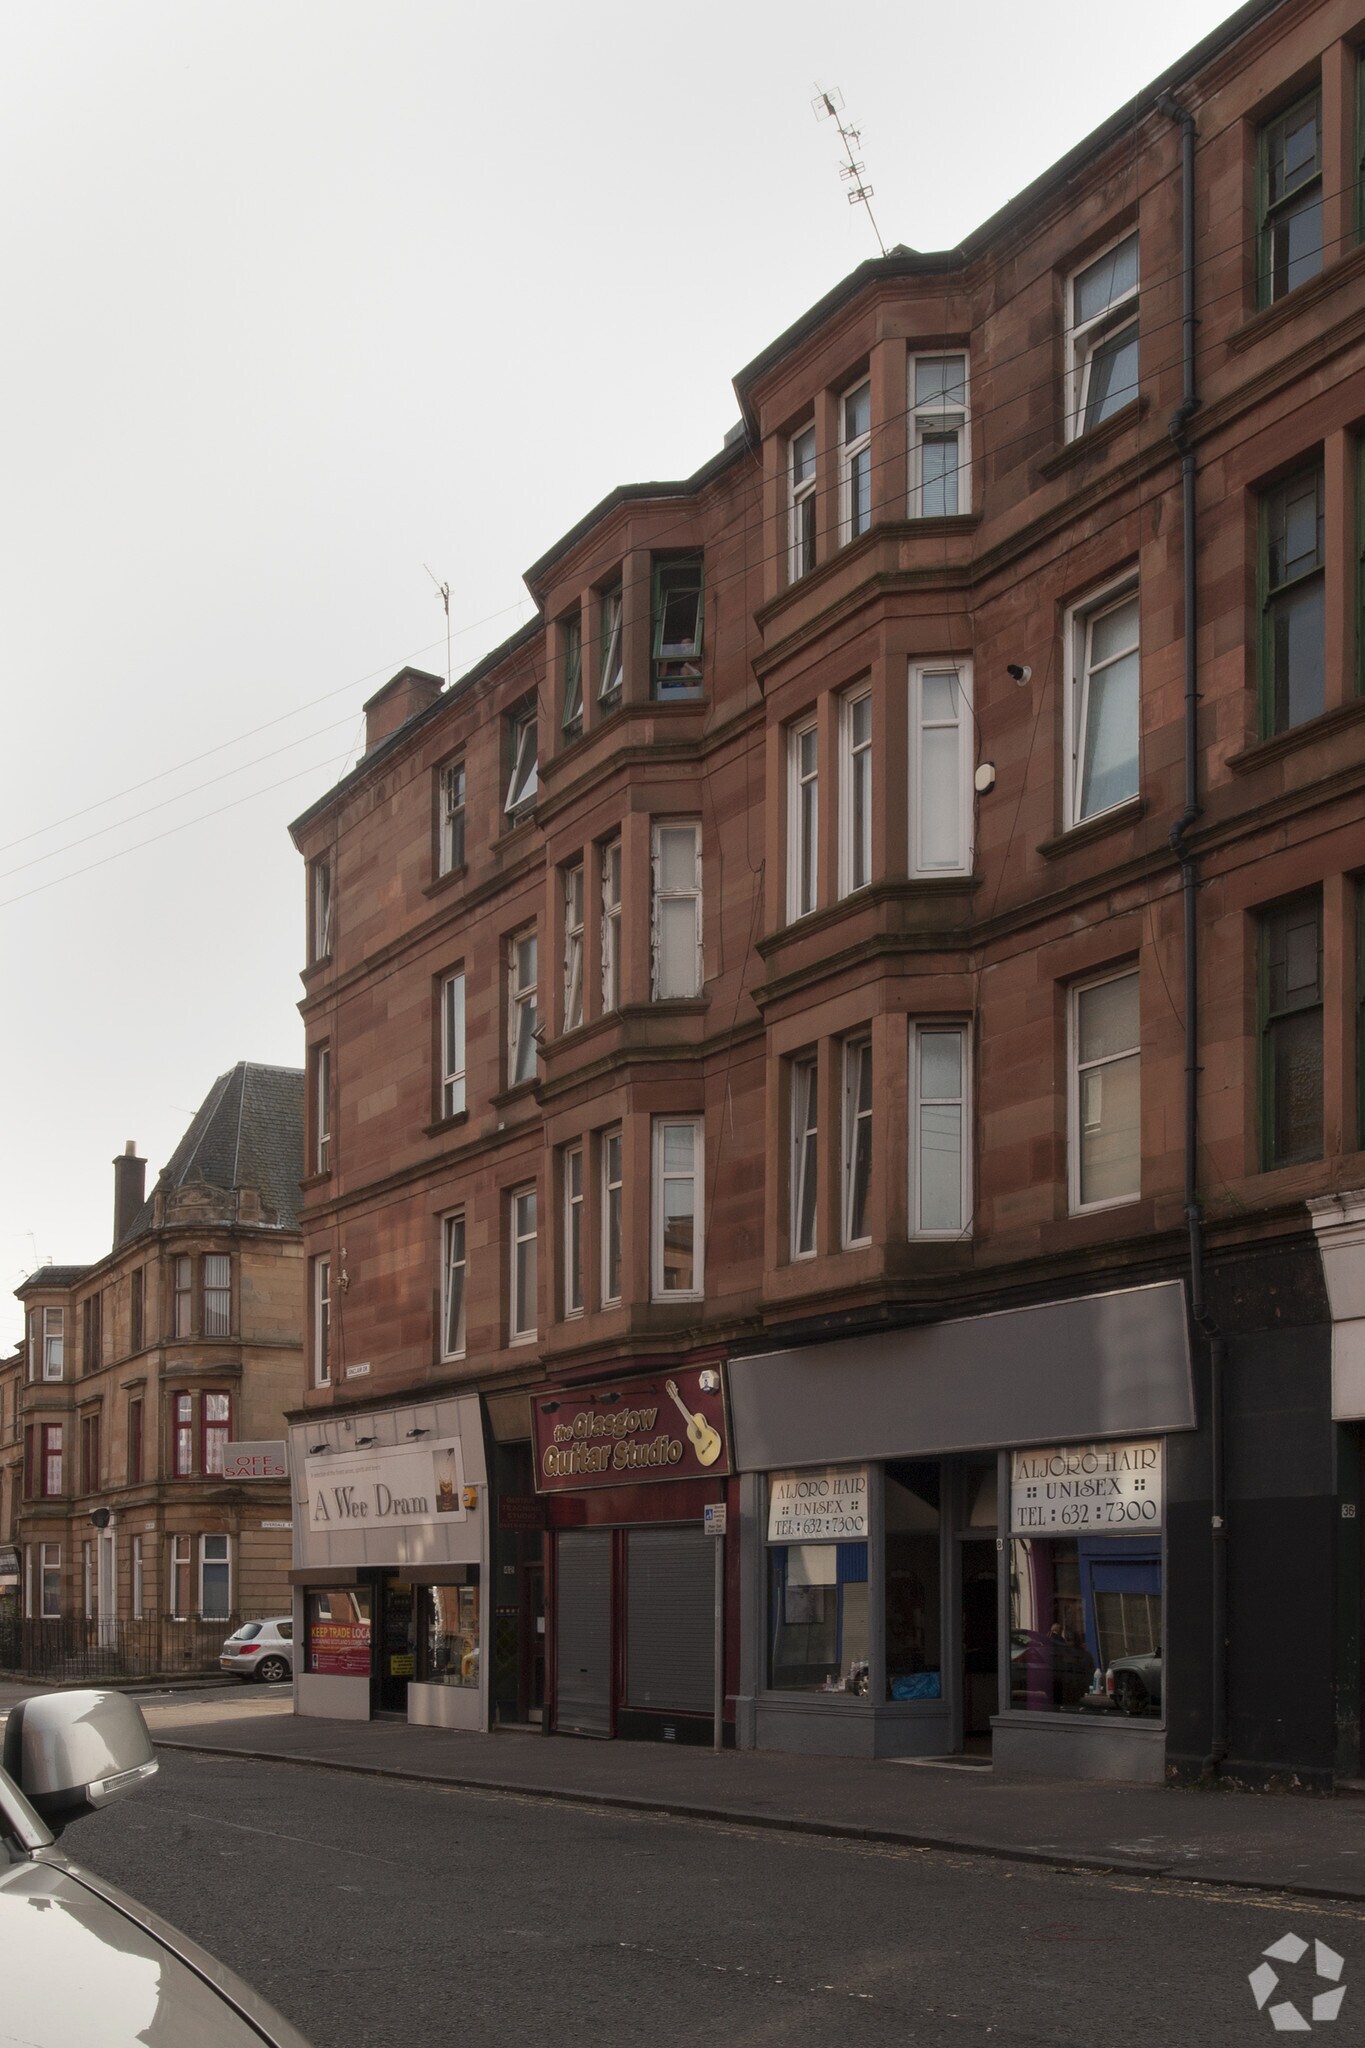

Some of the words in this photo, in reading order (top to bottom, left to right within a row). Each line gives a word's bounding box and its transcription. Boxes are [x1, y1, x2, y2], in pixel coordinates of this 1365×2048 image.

[554, 1424, 573, 1442] the
[572, 1408, 658, 1440] Glasgow
[236, 1455, 272, 1466] OFF
[543, 1442, 611, 1477] Guitar
[613, 1435, 683, 1470] Studio
[1018, 1453, 1098, 1480] ALJORO
[1106, 1448, 1156, 1472] HAIR
[225, 1466, 286, 1476] SALES
[778, 1480, 830, 1499] ALJORO
[832, 1478, 866, 1494] HAIR
[1046, 1478, 1123, 1499] UNISEX
[313, 1489, 331, 1521] A
[330, 1486, 368, 1518] Wee
[372, 1484, 429, 1517] Dram
[794, 1500, 843, 1516] UNISEX
[1017, 1506, 1046, 1526] TEL
[1062, 1504, 1090, 1524] 632
[1106, 1500, 1156, 1522] 7300
[1344, 1506, 1354, 1516] 36
[775, 1520, 793, 1535] TEL
[804, 1518, 822, 1534] 632
[832, 1516, 864, 1532] 7300
[312, 1627, 328, 1638] KEEP
[329, 1627, 350, 1639] TRADE
